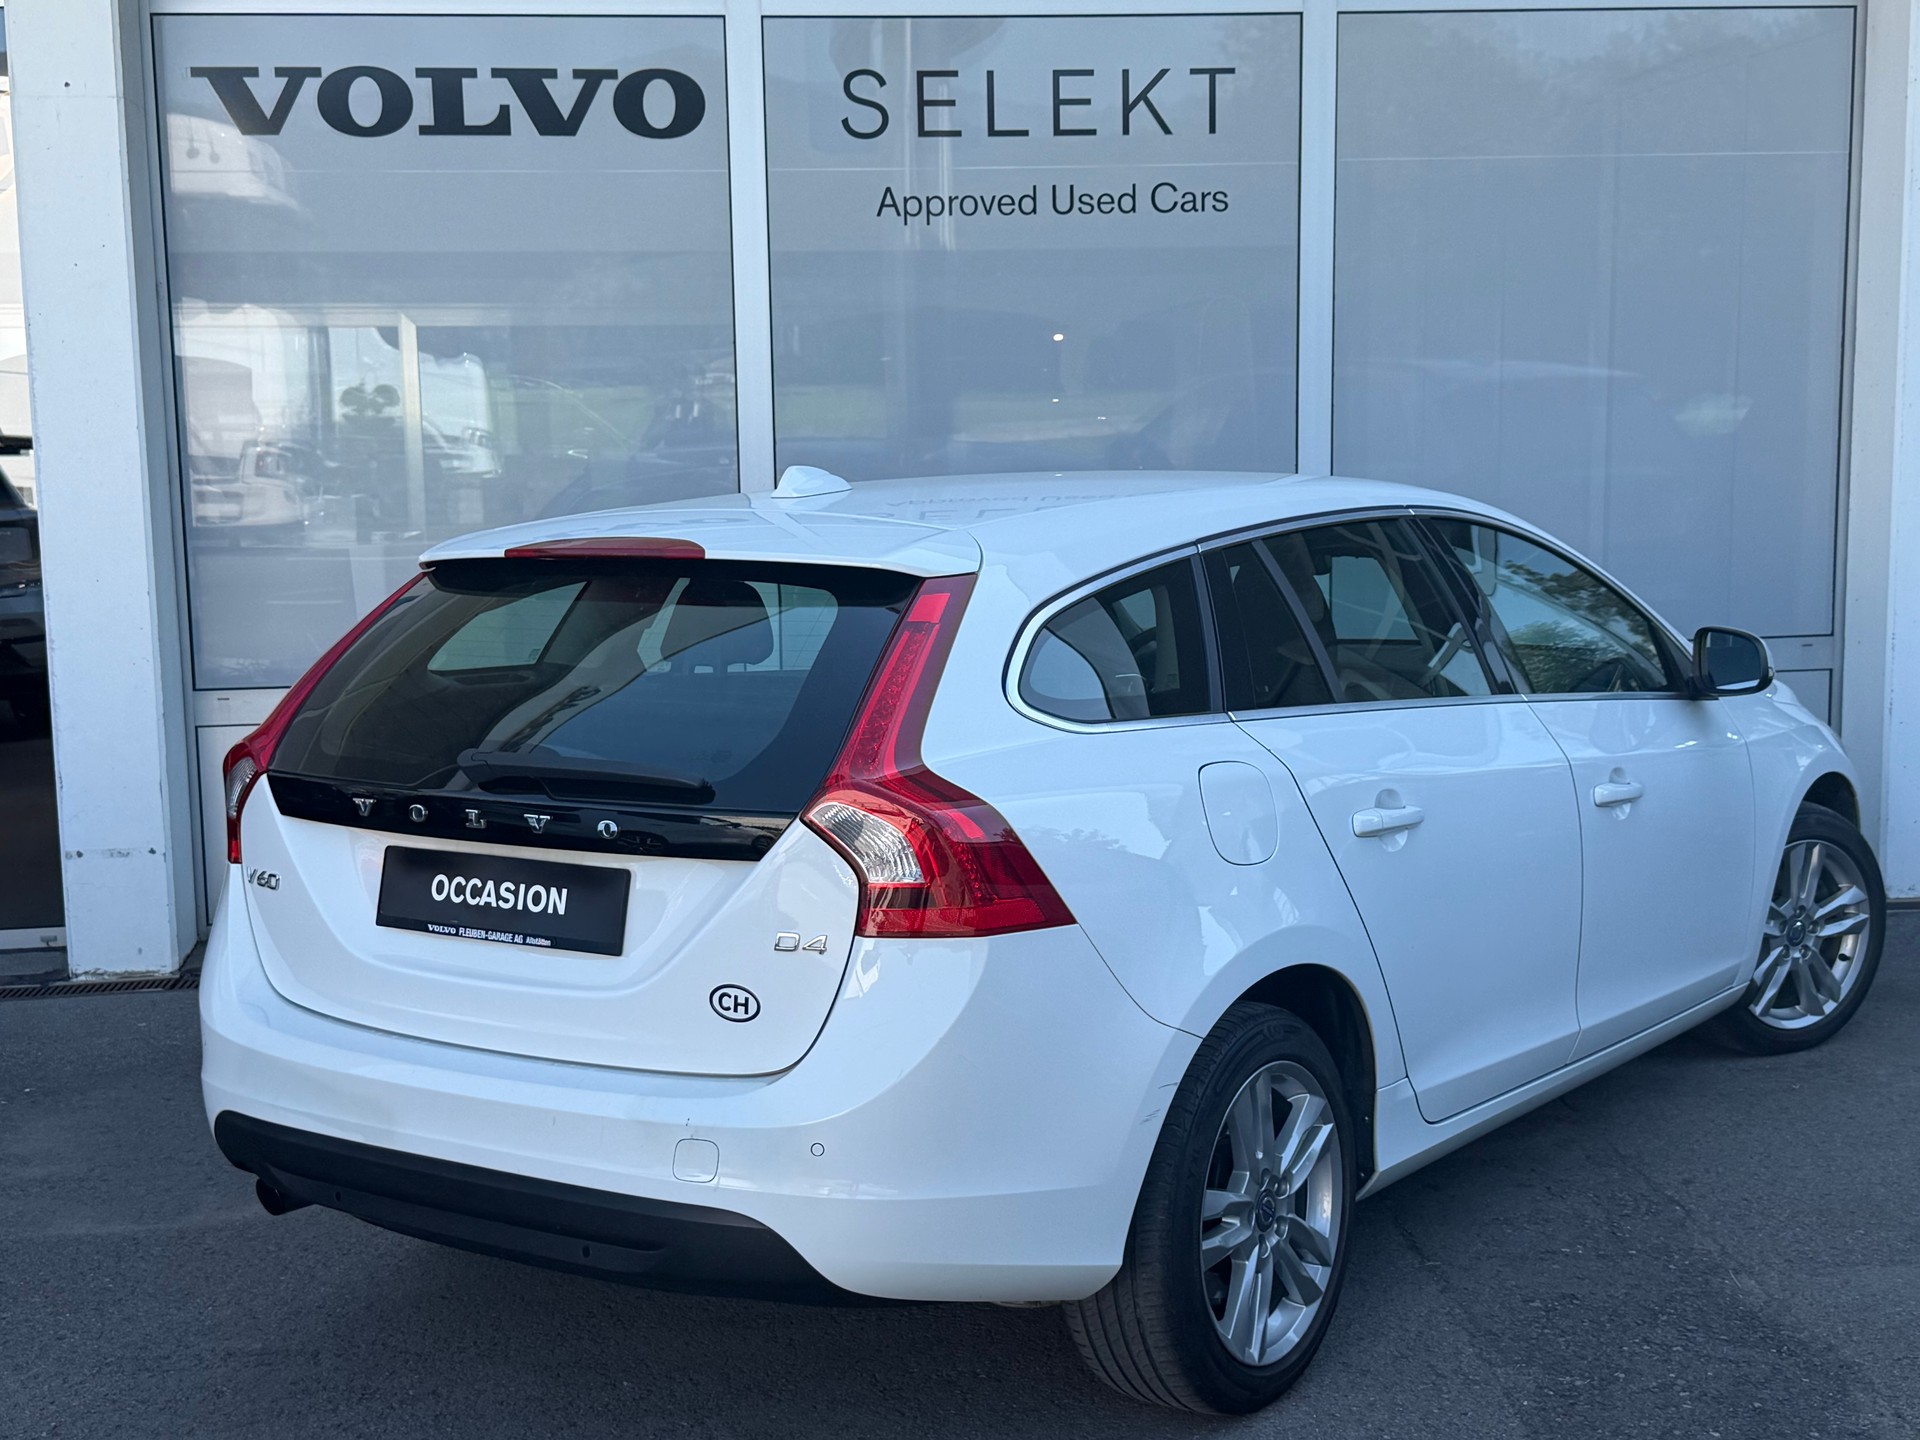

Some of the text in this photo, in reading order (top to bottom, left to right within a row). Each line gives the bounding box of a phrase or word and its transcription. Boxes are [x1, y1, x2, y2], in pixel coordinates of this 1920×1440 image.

[190, 65, 706, 139] VOLVO
[841, 67, 1236, 140] SELEKT
[876, 182, 1229, 226] Approved Used Cars
[352, 797, 619, 840] VOLVO
[246, 866, 281, 891] V60
[431, 873, 568, 915] OCCASION
[427, 924, 456, 934] VOLVO
[774, 931, 828, 955] D4
[717, 991, 750, 1015] CH
